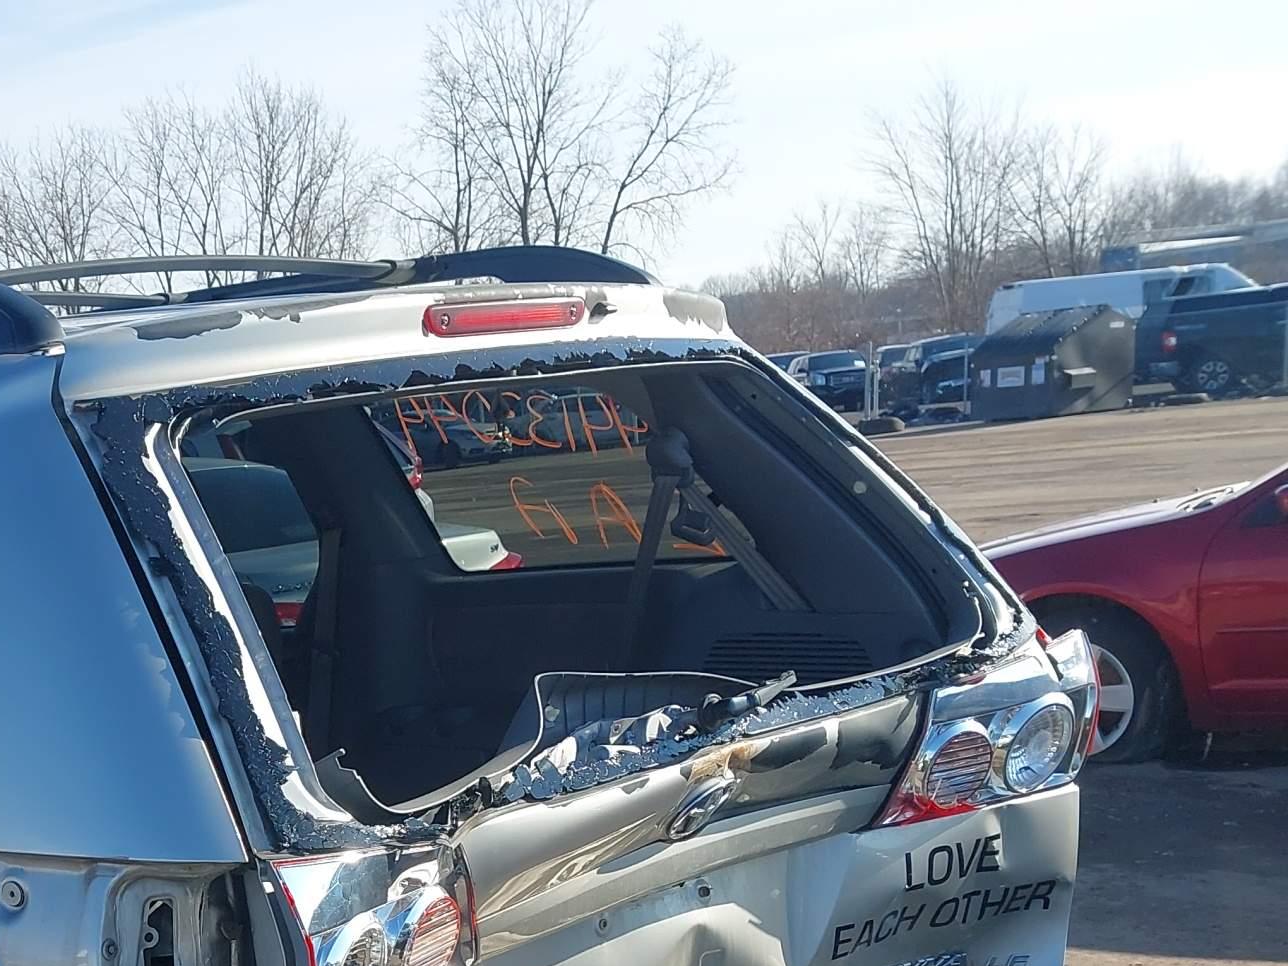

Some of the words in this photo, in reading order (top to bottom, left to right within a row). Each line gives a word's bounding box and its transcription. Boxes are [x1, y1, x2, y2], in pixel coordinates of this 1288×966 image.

[904, 833, 1002, 892] LOVE
[831, 902, 926, 960] EACH
[928, 879, 1057, 928] OTHER
